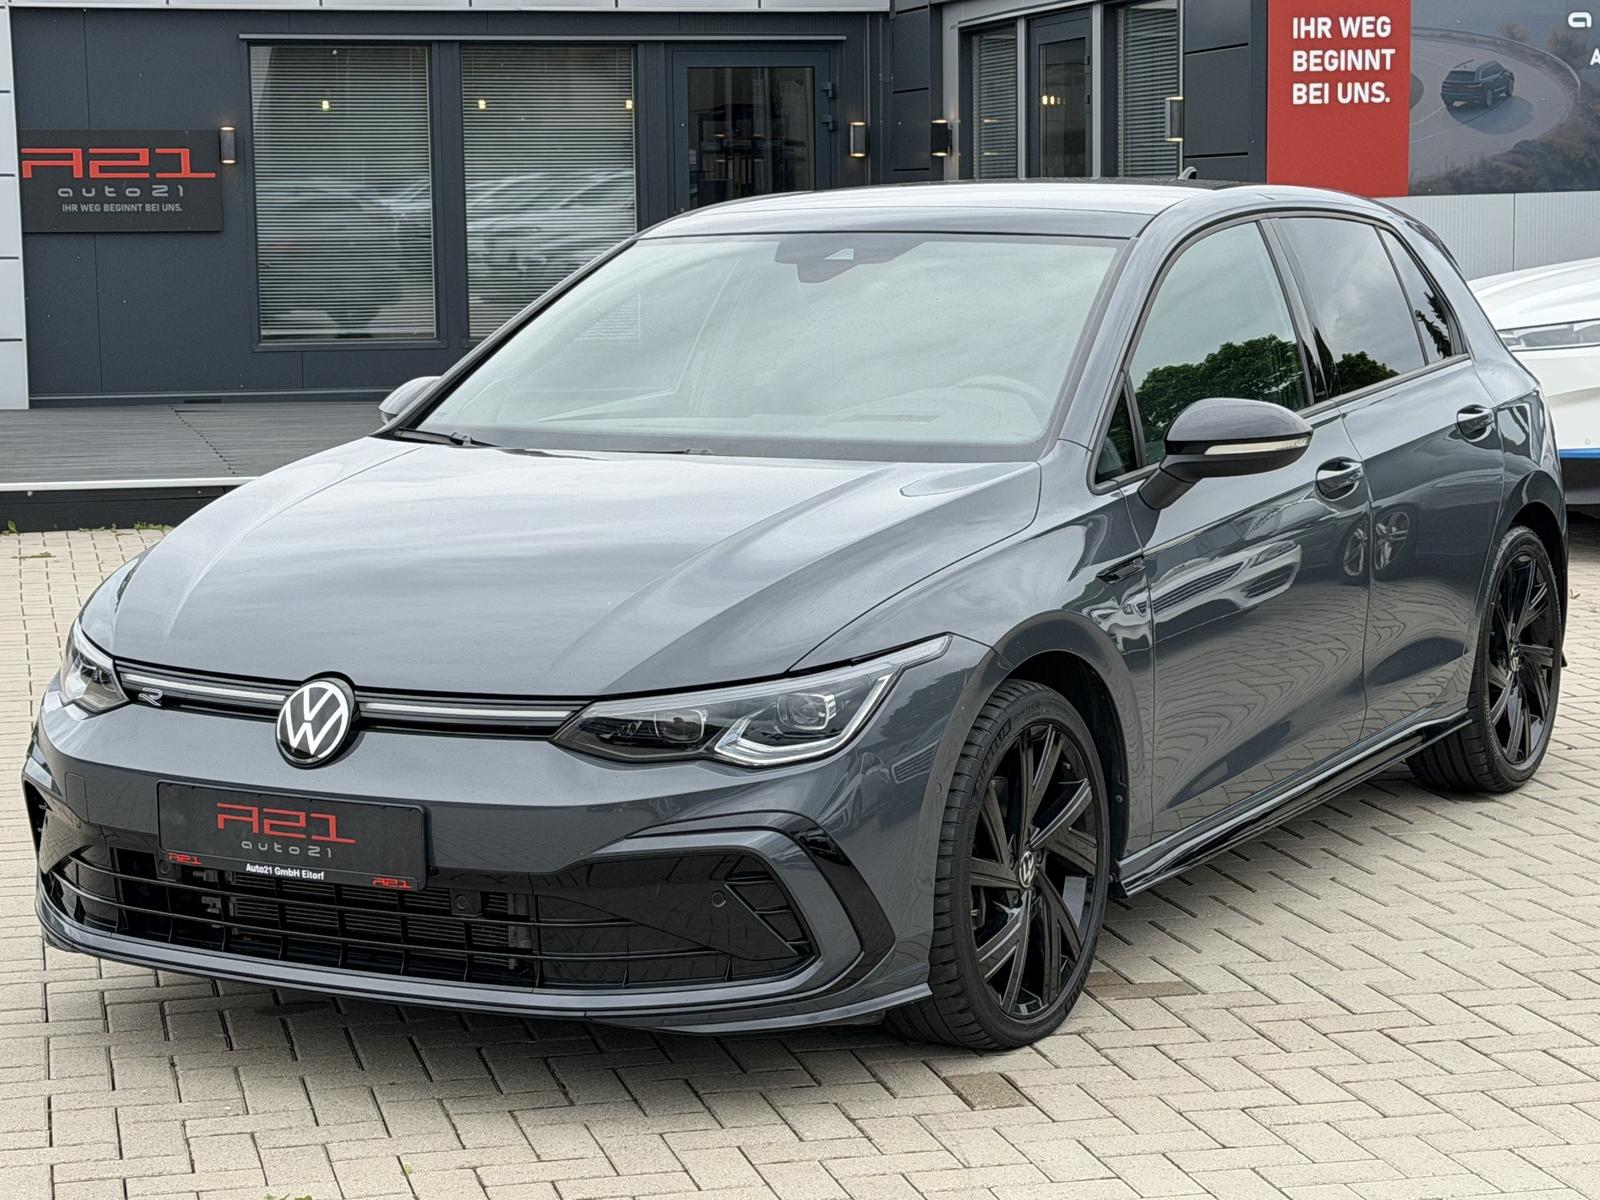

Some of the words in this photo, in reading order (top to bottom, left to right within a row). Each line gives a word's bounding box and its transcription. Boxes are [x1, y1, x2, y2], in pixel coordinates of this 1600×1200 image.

[1292, 16, 1332, 39] IHR
[1338, 15, 1392, 38] WEG
[1292, 48, 1396, 72] BEGINNT
[1292, 82, 1330, 105] BEI
[1337, 81, 1391, 104] UNS.
[20, 147, 217, 179] A21
[57, 184, 184, 198] auto21
[62, 203, 78, 212] IHR
[80, 203, 101, 212] WEG
[103, 203, 143, 212] BEGINNT
[145, 203, 160, 212] BEI
[161, 203, 184, 212] UNS.
[216, 802, 356, 845] A21
[241, 840, 332, 859] auto21
[245, 862, 273, 875] Auto21
[274, 866, 300, 878] GmbH
[301, 869, 325, 881] Eitorf
